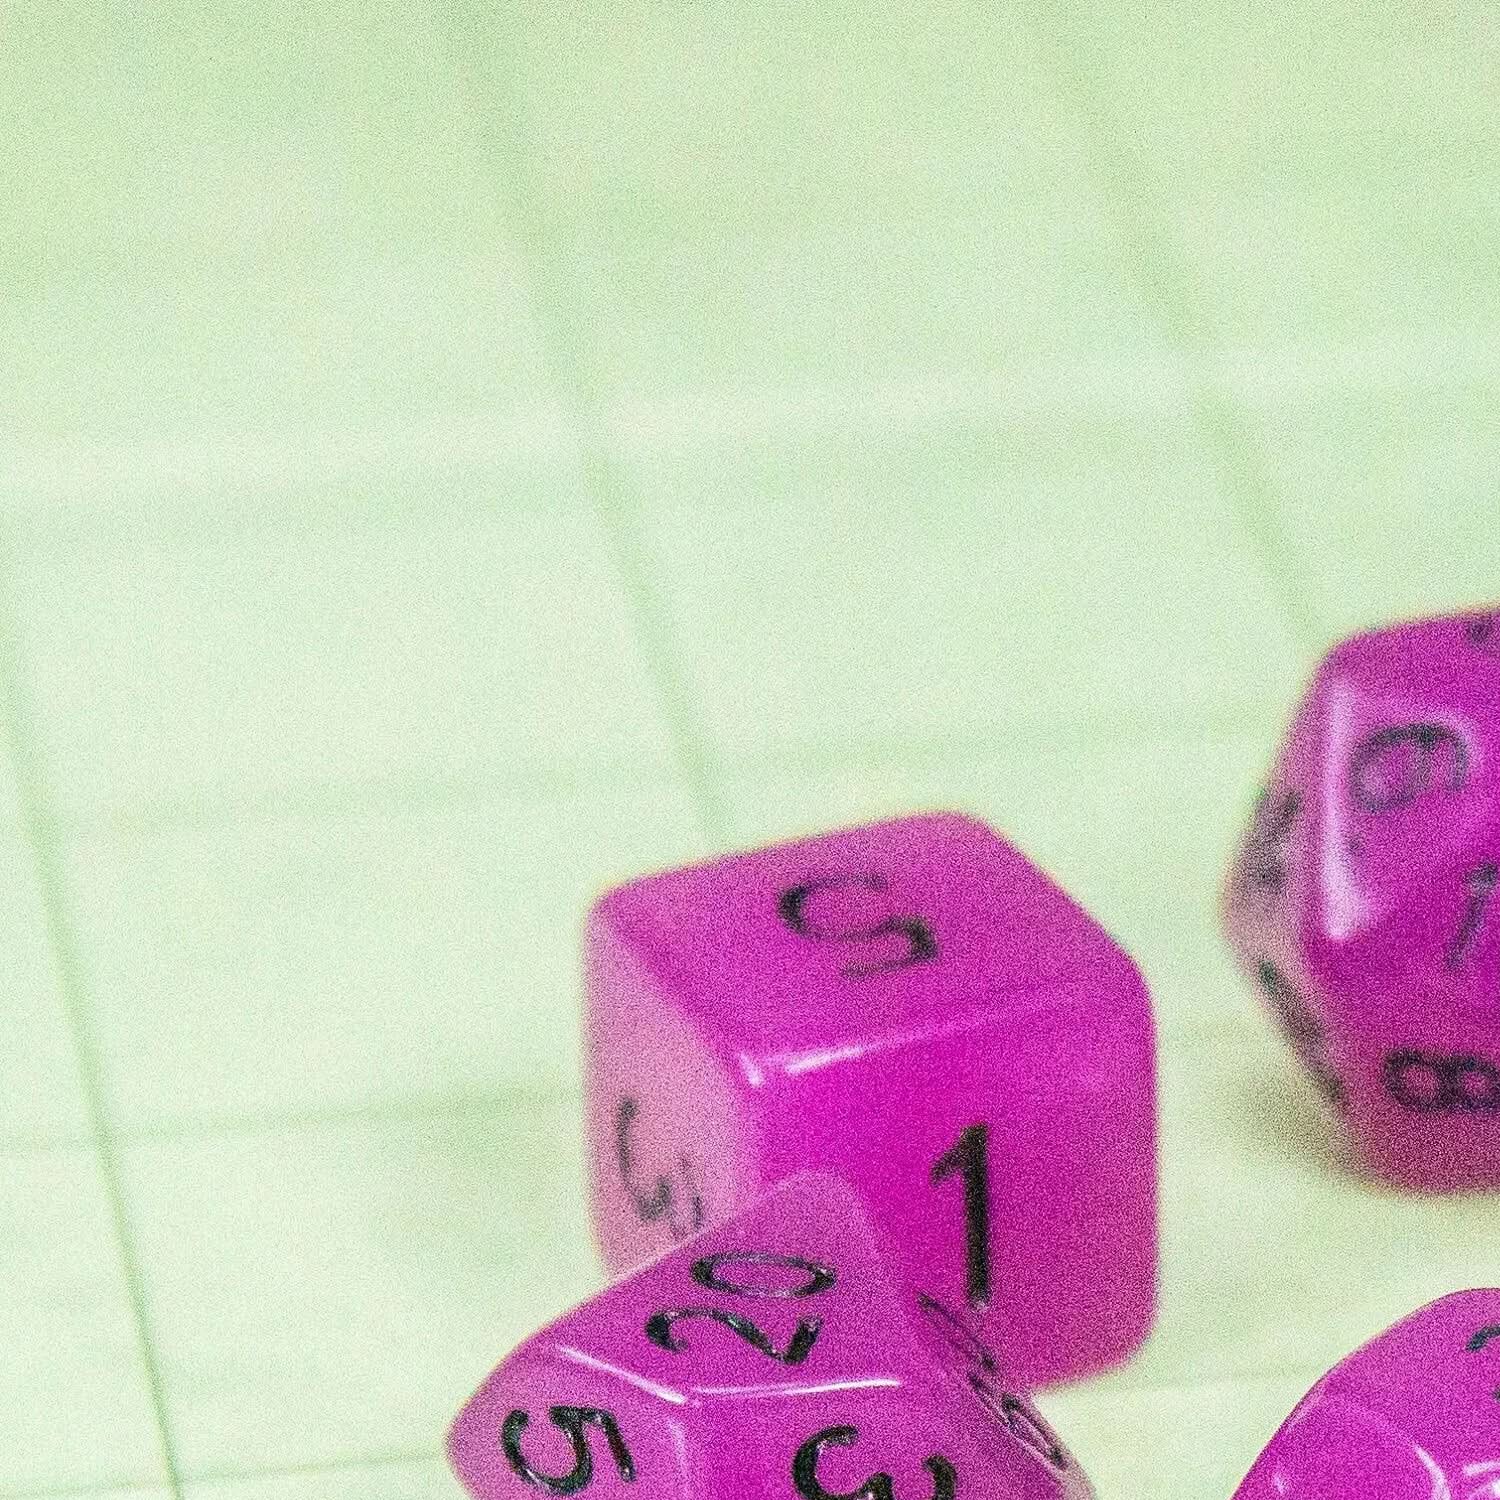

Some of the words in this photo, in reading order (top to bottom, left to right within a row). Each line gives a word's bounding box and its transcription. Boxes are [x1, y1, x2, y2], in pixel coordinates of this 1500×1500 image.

[774, 872, 940, 980] 5
[926, 1120, 992, 1308] 1
[644, 1250, 838, 1366] 20
